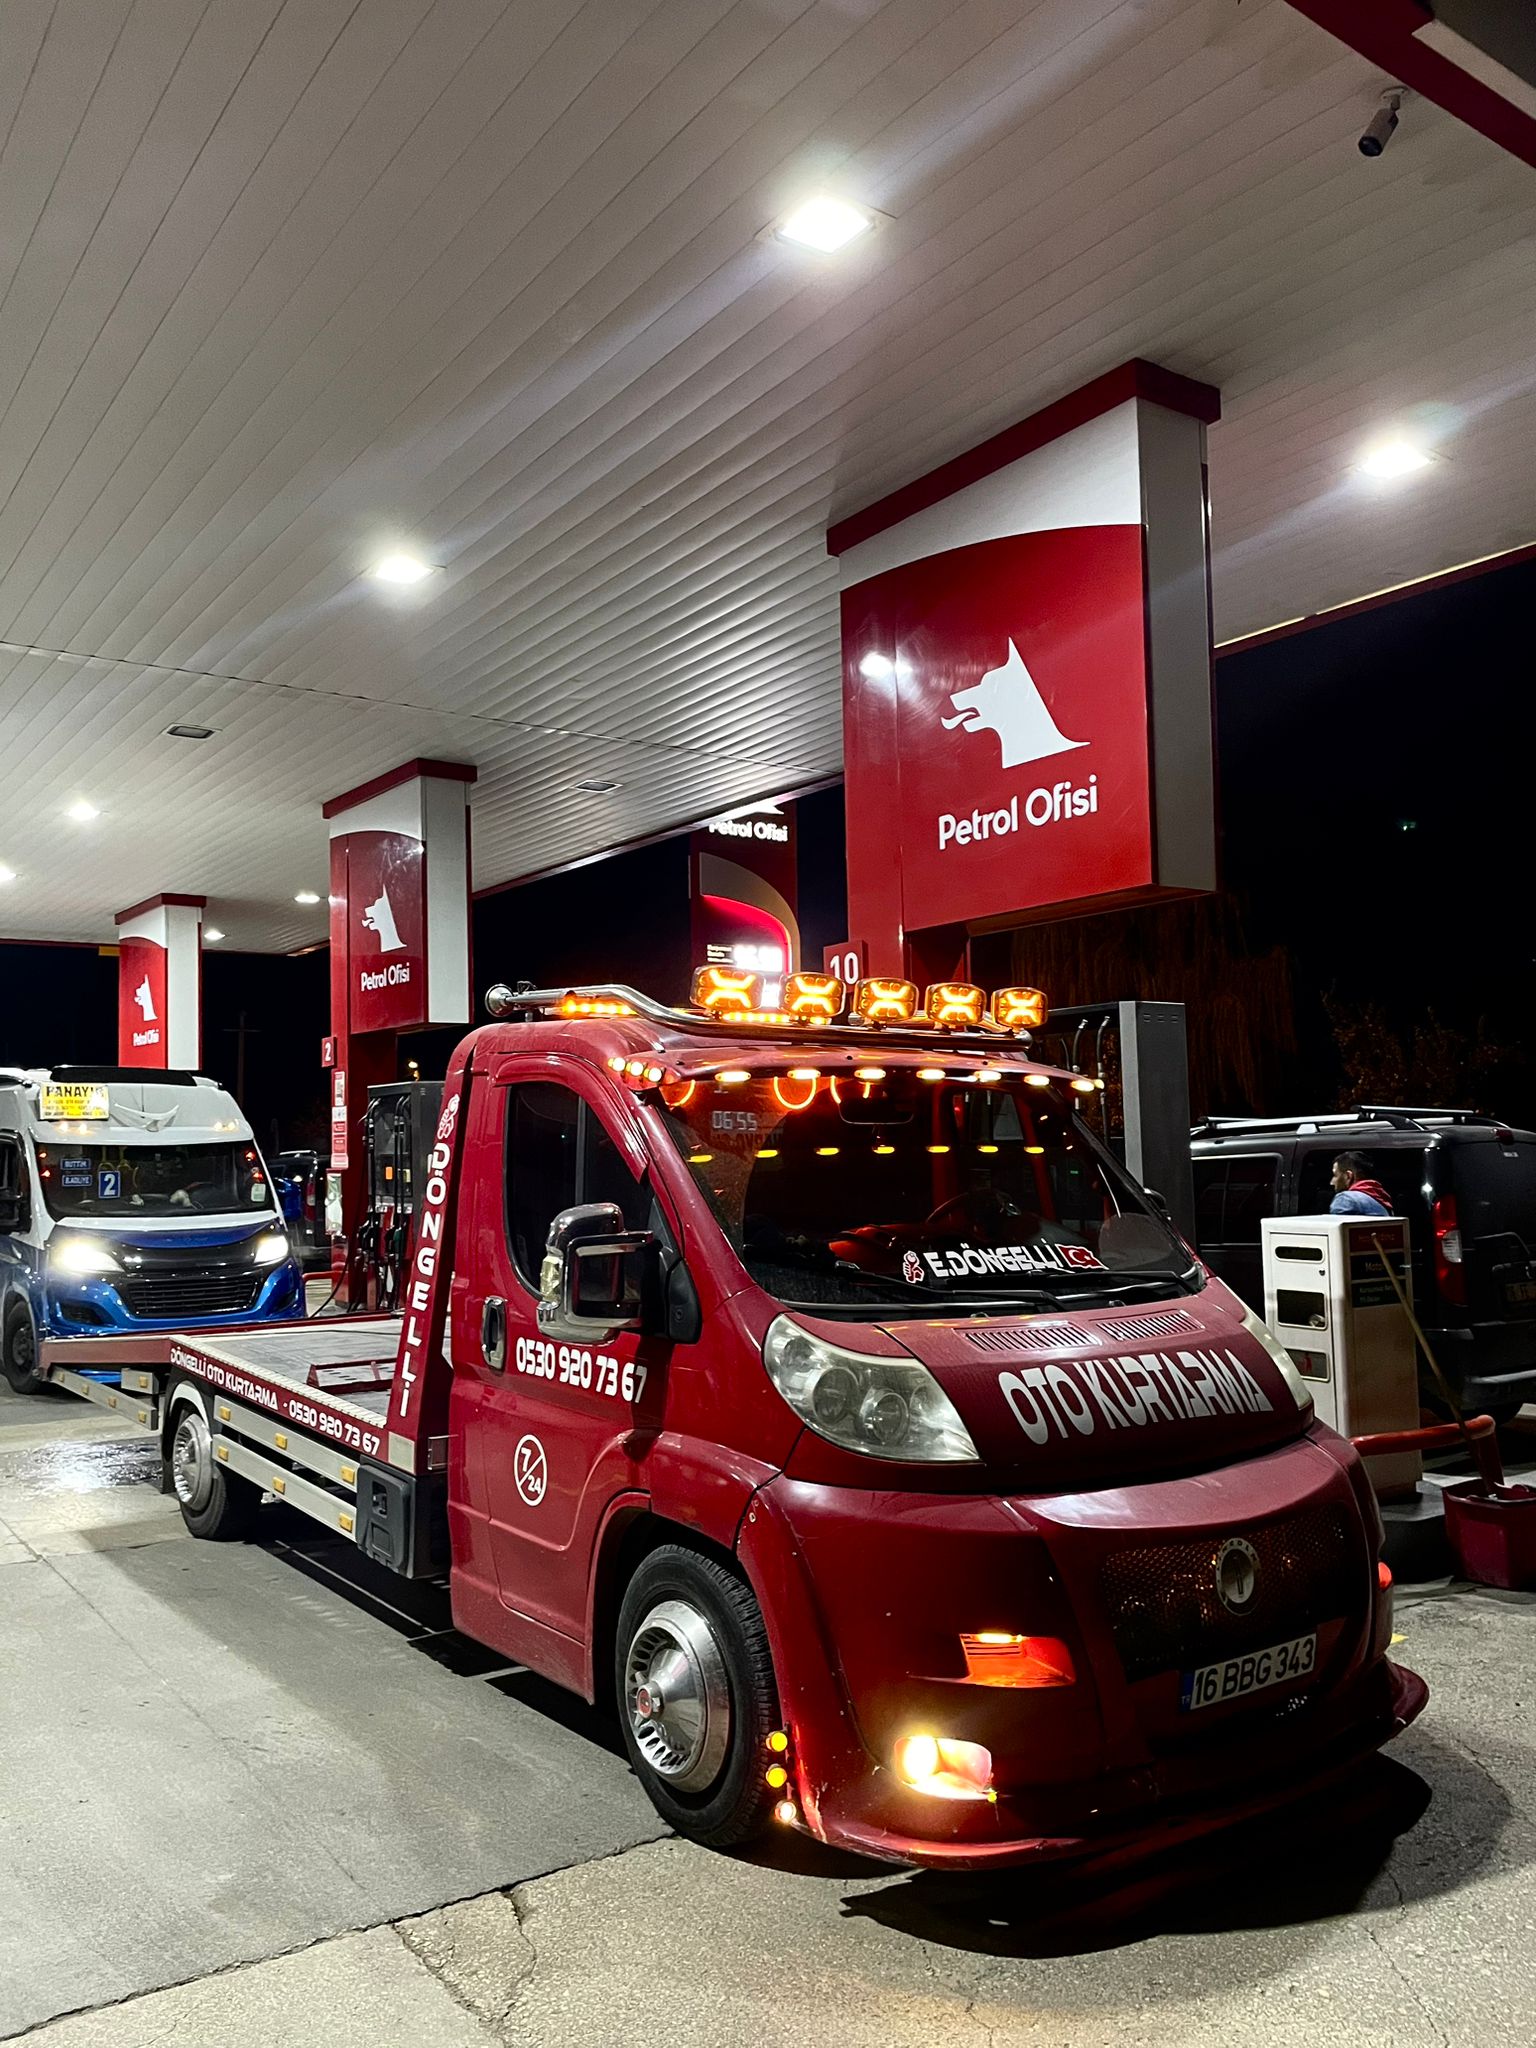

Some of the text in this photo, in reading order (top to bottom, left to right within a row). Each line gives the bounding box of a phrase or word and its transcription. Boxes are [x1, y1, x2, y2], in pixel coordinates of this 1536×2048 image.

[753, 822, 788, 842] Ofisi
[938, 774, 1098, 850] Petrol Ofisi
[361, 962, 410, 992] Petrol Ofisi
[829, 951, 859, 985] 10
[325, 1042, 332, 1062] 2
[103, 1173, 116, 1196] 2
[399, 1142, 451, 1417] DÖNGELLİ
[515, 1336, 648, 1404] 0530 920 73 67
[998, 1348, 1274, 1445] OTO KURTARMA
[206, 1363, 225, 1388] OTO
[225, 1371, 279, 1411] KURTARMA
[288, 1399, 318, 1428] 0530
[318, 1414, 343, 1440] 920
[344, 1423, 361, 1447] 73
[362, 1433, 380, 1456] 67
[1195, 1637, 1314, 1706] 16 BBG 343
